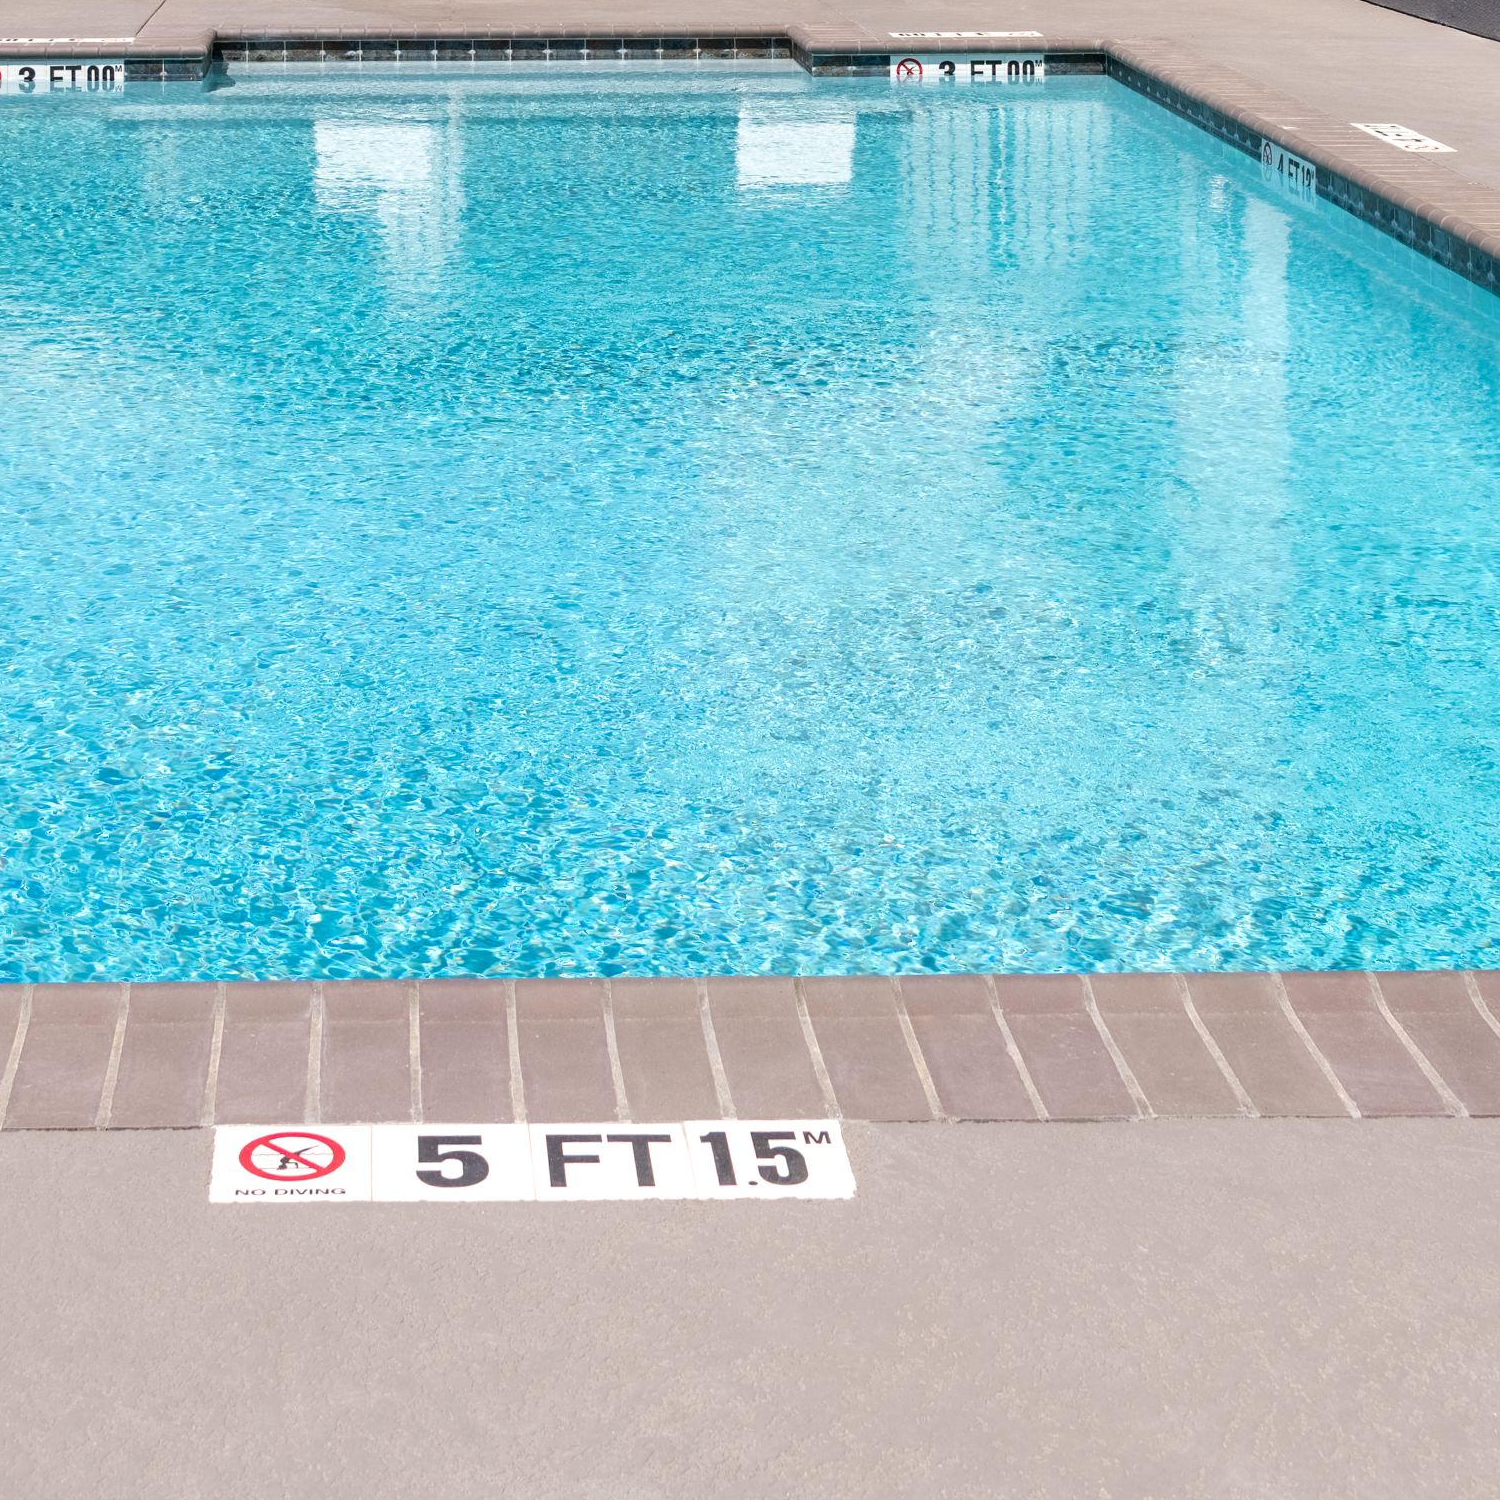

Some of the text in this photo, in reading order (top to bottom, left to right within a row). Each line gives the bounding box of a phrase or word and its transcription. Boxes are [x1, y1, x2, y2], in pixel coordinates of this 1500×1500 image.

[18, 66, 35, 81] 3
[50, 65, 82, 81] FT
[938, 60, 956, 76] 3
[970, 60, 1002, 76] FT
[416, 1135, 489, 1188] 5
[545, 1134, 672, 1187] FT
[235, 1188, 346, 1196] NO DIVING
